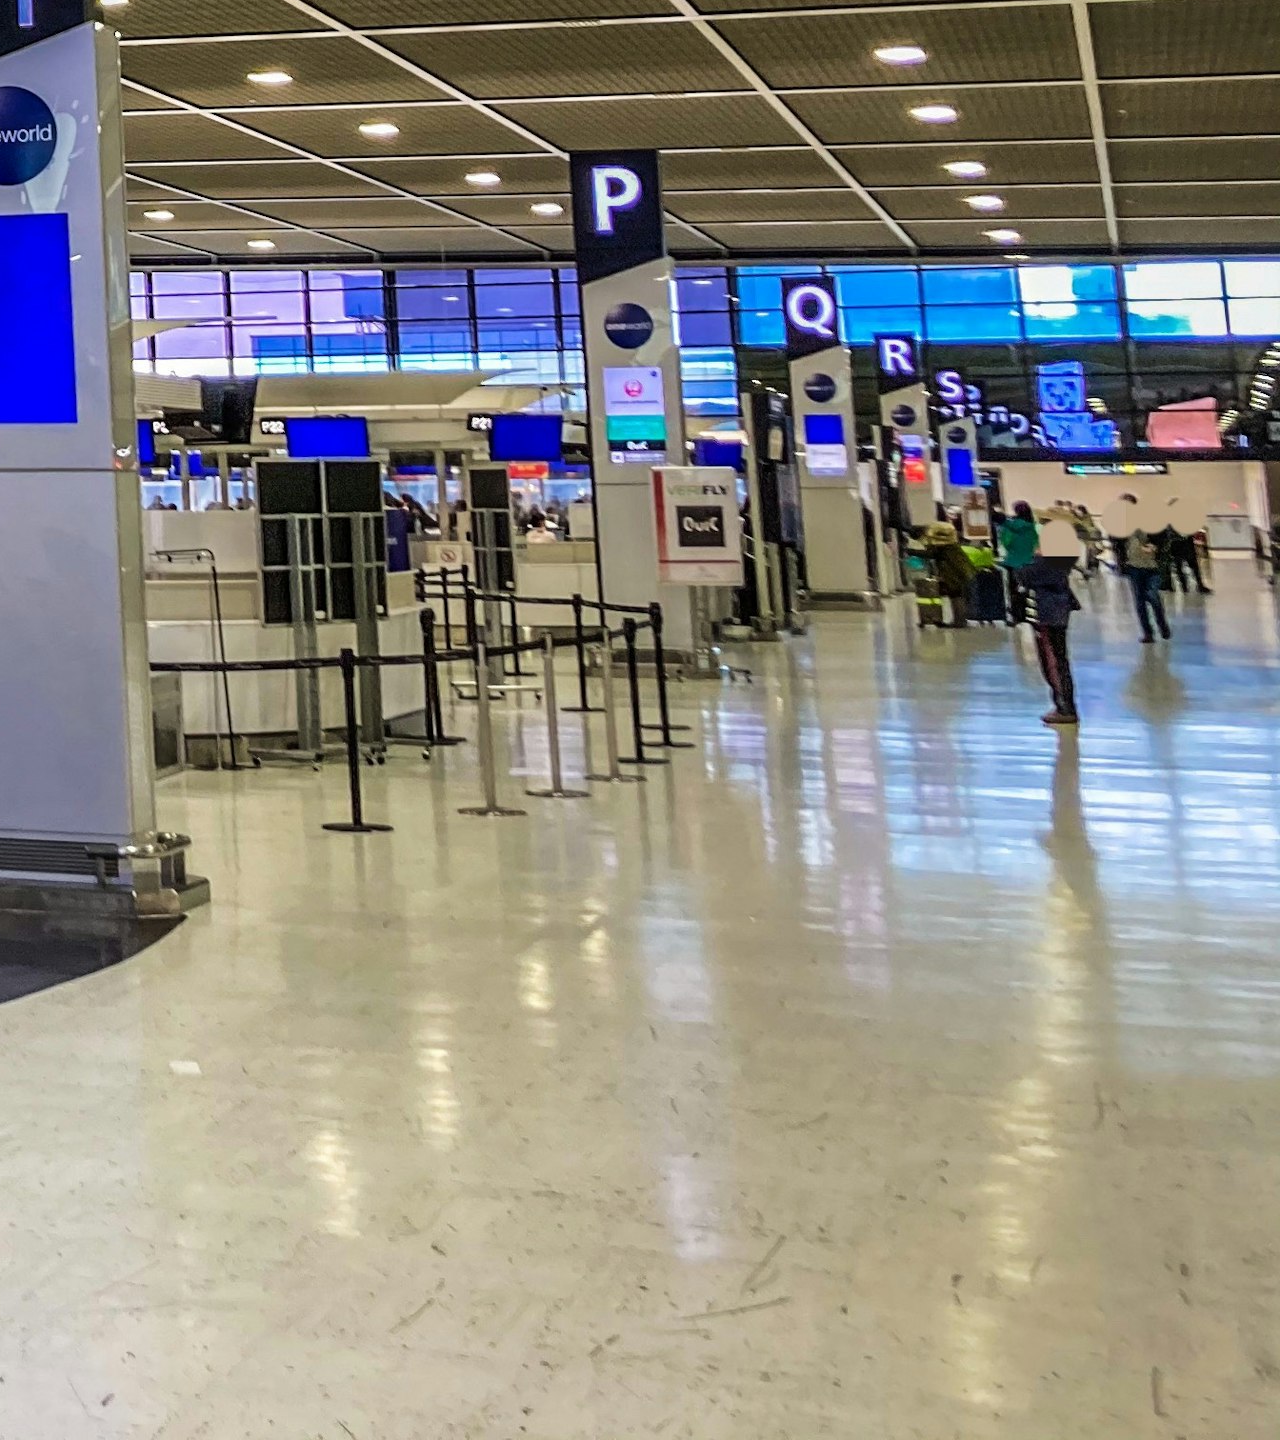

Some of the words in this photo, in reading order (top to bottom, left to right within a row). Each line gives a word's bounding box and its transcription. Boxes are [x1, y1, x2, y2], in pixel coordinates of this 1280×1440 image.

[591, 166, 643, 236] P
[787, 284, 835, 338] Q
[879, 338, 915, 376] R
[937, 369, 963, 401] S
